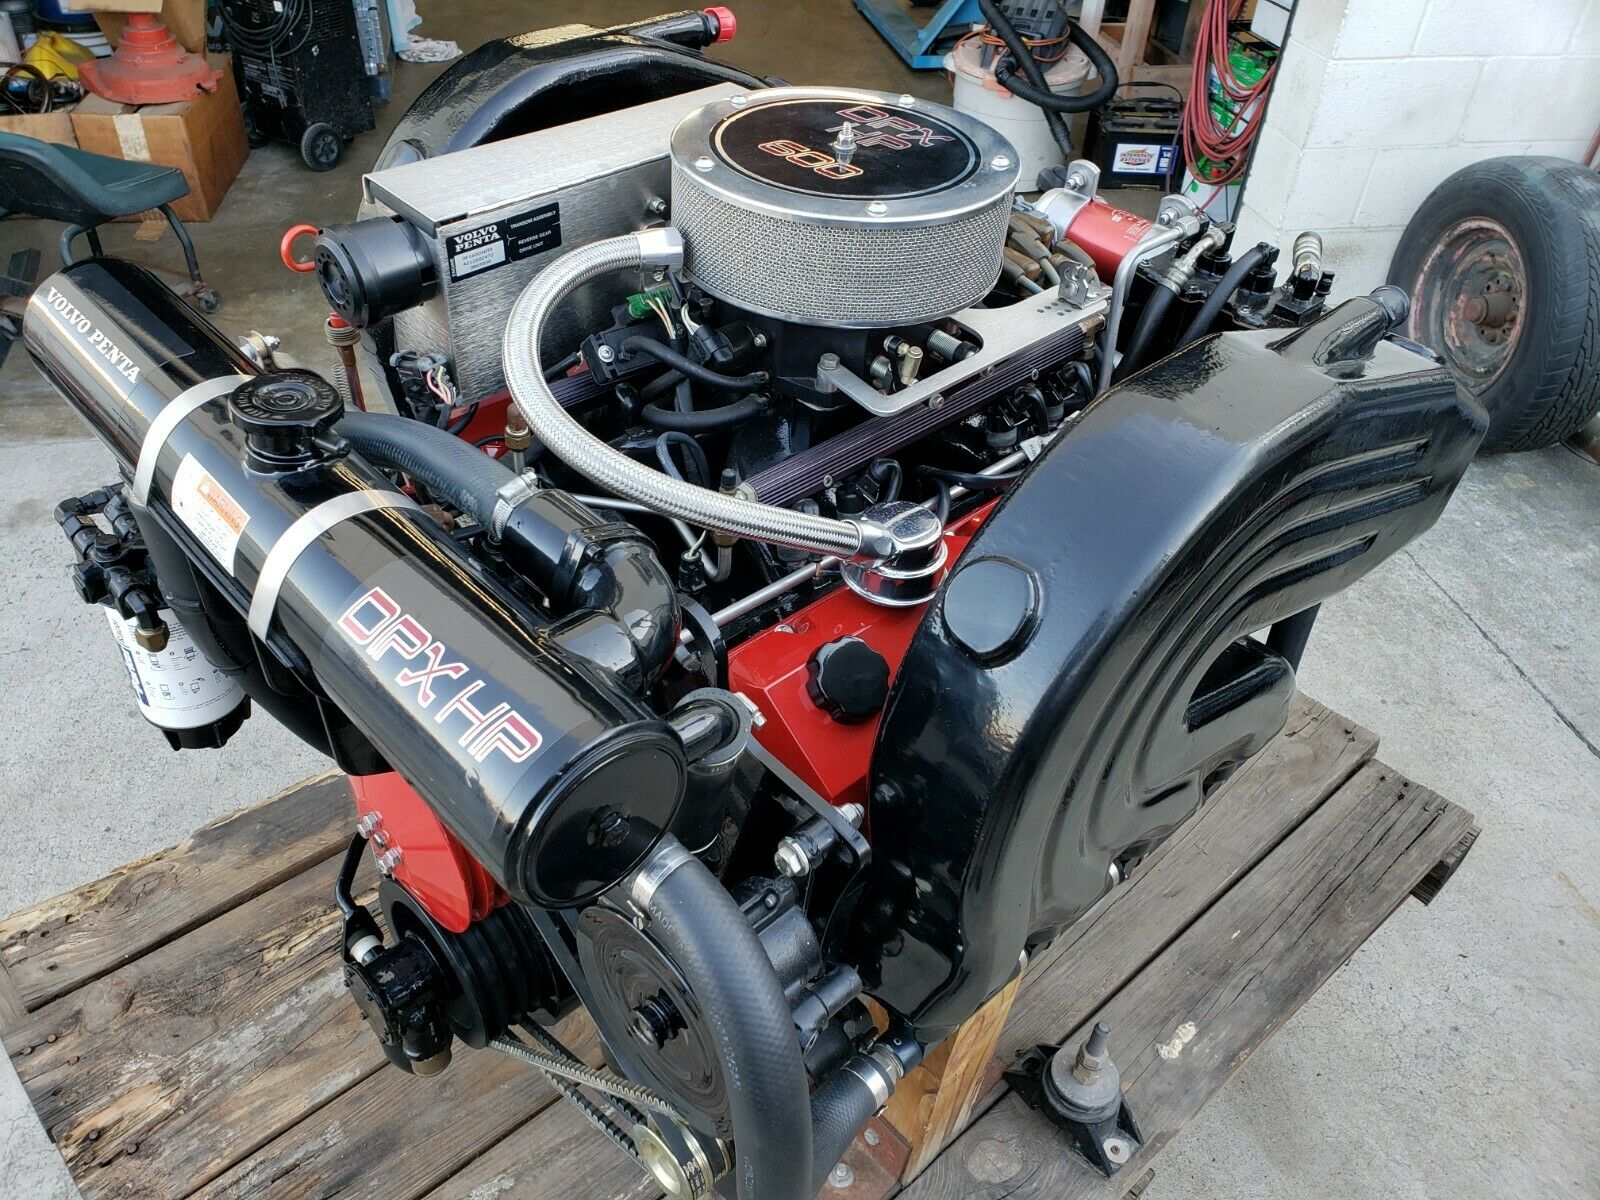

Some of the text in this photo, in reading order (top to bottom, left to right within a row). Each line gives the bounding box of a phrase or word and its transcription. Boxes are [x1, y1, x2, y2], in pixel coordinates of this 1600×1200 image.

[825, 123, 912, 150] HP
[835, 105, 956, 147] DPX
[758, 140, 864, 179] 600
[510, 210, 557, 230] TRANSOM ASSEMBLY
[453, 224, 498, 244] VOLVO
[455, 232, 501, 252] PENTA
[518, 234, 539, 245] REVERSE
[46, 286, 141, 384] VOLVO PENTA
[337, 586, 543, 763] DPX HP
